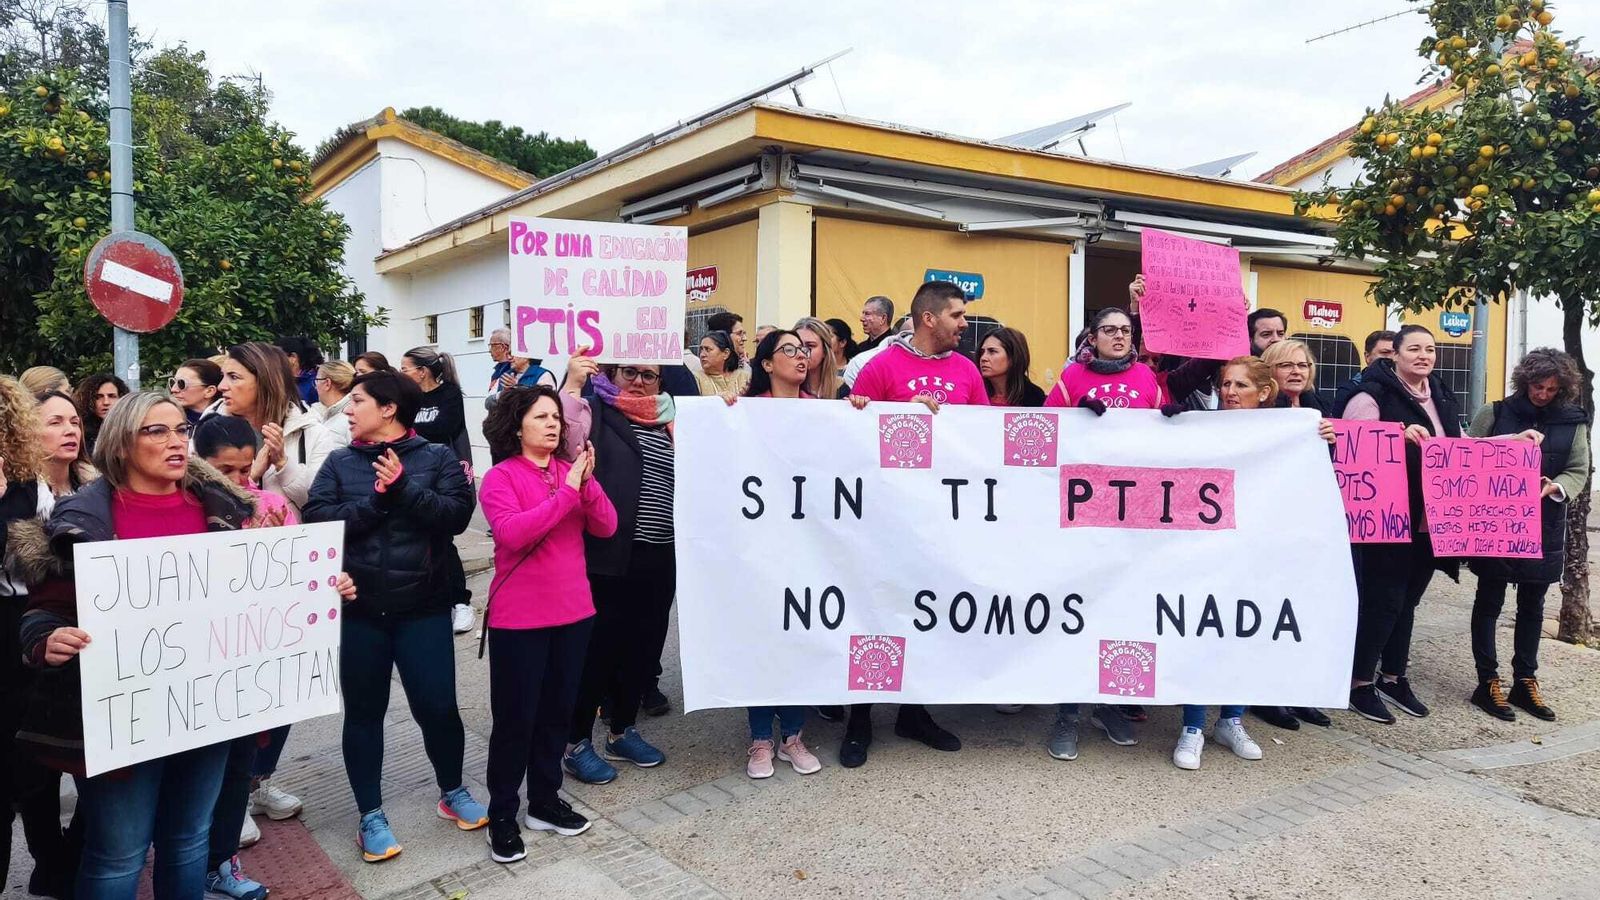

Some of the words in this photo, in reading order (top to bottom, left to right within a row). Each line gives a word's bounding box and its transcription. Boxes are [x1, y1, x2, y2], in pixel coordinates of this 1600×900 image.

[510, 221, 548, 256] POR
[555, 232, 593, 258] UNA
[543, 267, 568, 296] DE
[582, 266, 668, 297] CALIDAD
[636, 306, 668, 330] EN
[1308, 303, 1340, 318] Mahou
[516, 303, 604, 358] PTIS
[613, 333, 683, 360] LUCHA
[907, 376, 955, 391] PTIS
[1088, 383, 1140, 398] PTIS
[1331, 426, 1362, 464] IN
[1369, 429, 1401, 465] TI
[1425, 442, 1454, 469] SIN
[1456, 446, 1473, 468] TI
[1474, 440, 1518, 468] PTIS
[1522, 445, 1541, 470] NO
[741, 475, 863, 521] SIN
[941, 478, 998, 522] TI
[1067, 478, 1222, 525] PTIS
[1431, 474, 1479, 500] SOMOS
[1488, 474, 1528, 499] NADA
[1381, 502, 1411, 540] NADA
[1444, 505, 1464, 517] LOS
[1469, 504, 1517, 517] DERECHOS
[1522, 507, 1537, 518] DE
[1468, 520, 1498, 533] HIJOS
[90, 548, 209, 612] JUAN
[229, 528, 308, 593] JOSÉ
[783, 585, 846, 631] NO
[913, 589, 1085, 635] SOMOS
[1156, 593, 1303, 643] NADA
[115, 622, 187, 681] LOS
[208, 602, 304, 663] NIÑOS
[97, 687, 150, 751] TE
[167, 645, 341, 737] NECESITAN
